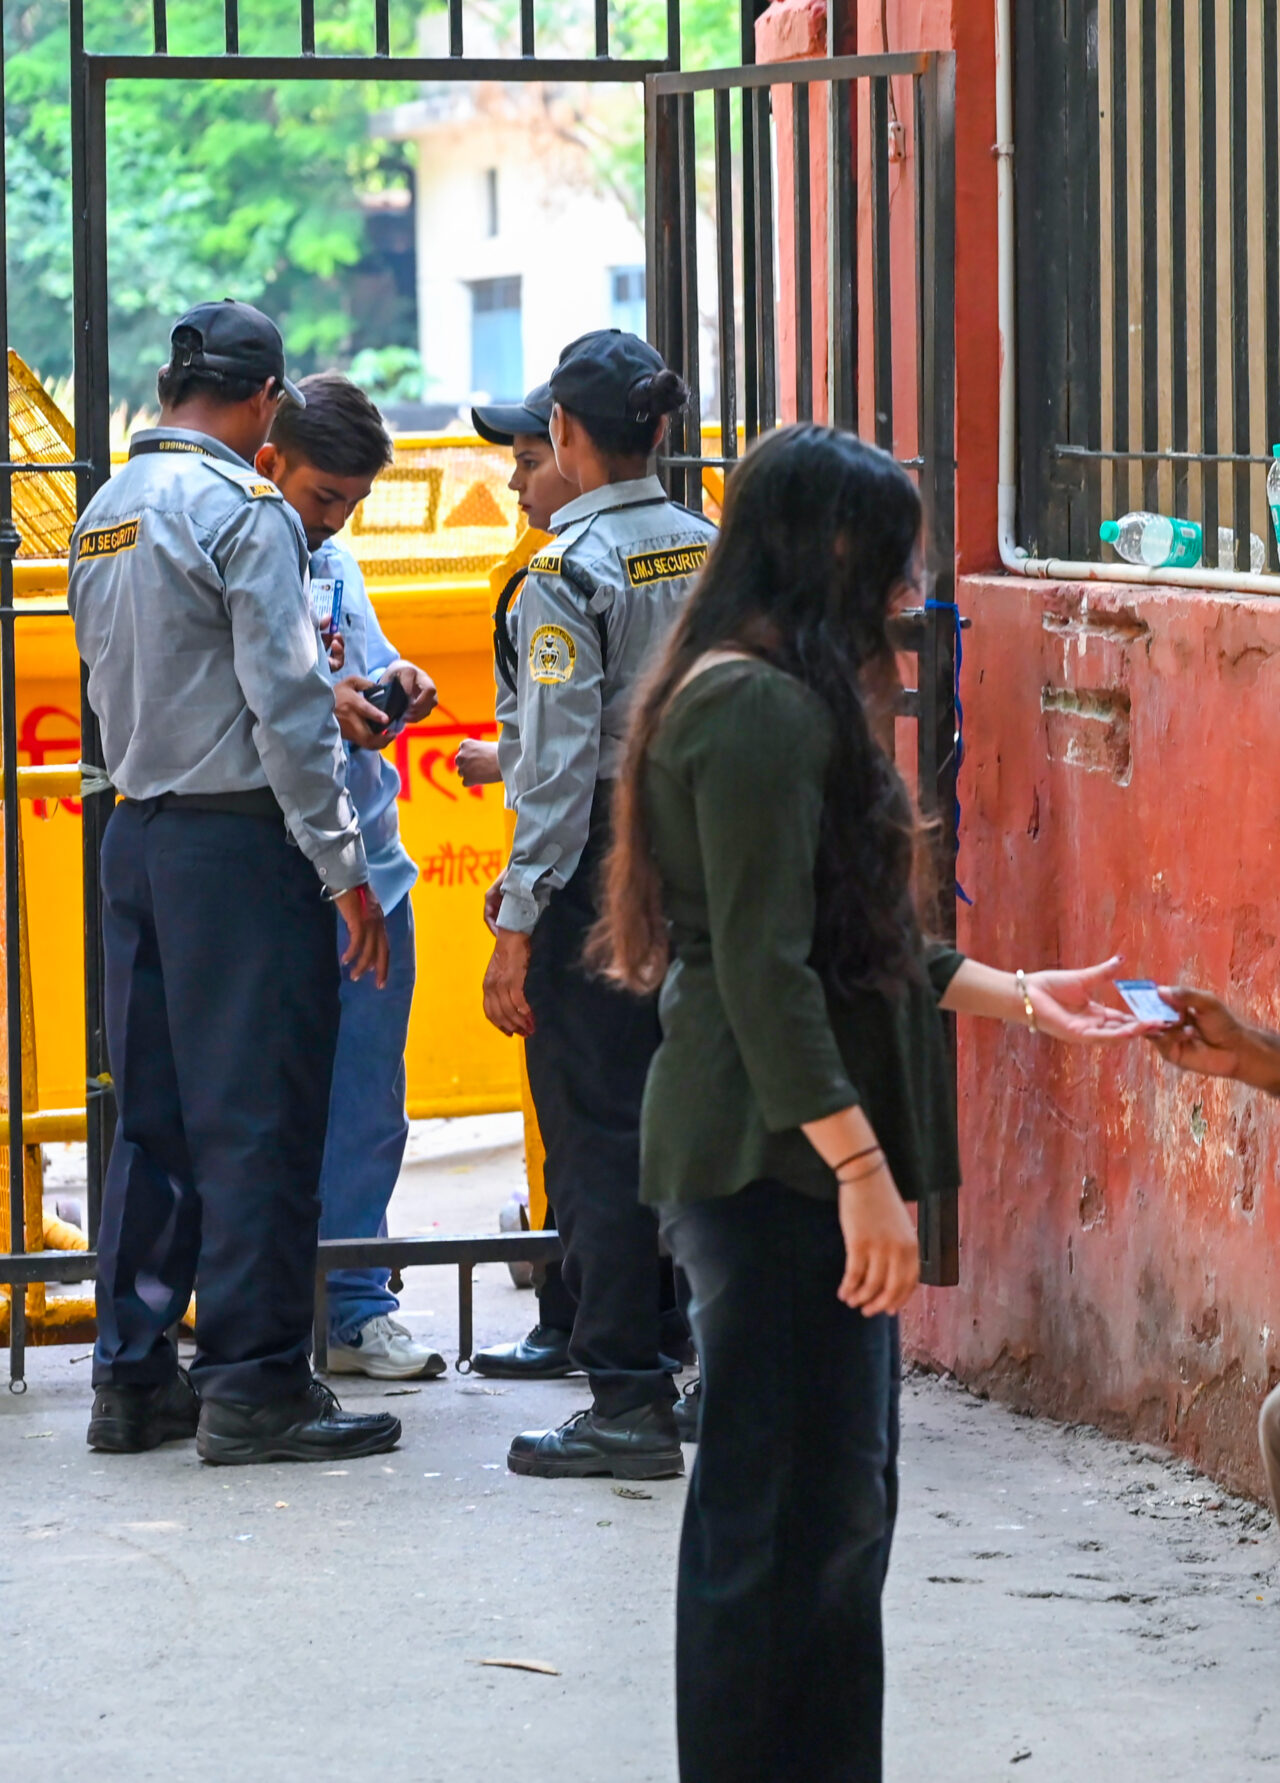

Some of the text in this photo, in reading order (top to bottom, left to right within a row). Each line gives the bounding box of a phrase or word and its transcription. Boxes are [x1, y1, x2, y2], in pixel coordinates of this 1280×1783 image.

[97, 525, 138, 552] SECURITY
[533, 556, 556, 570] JMJ
[632, 550, 707, 580] JMJ SECURITY
